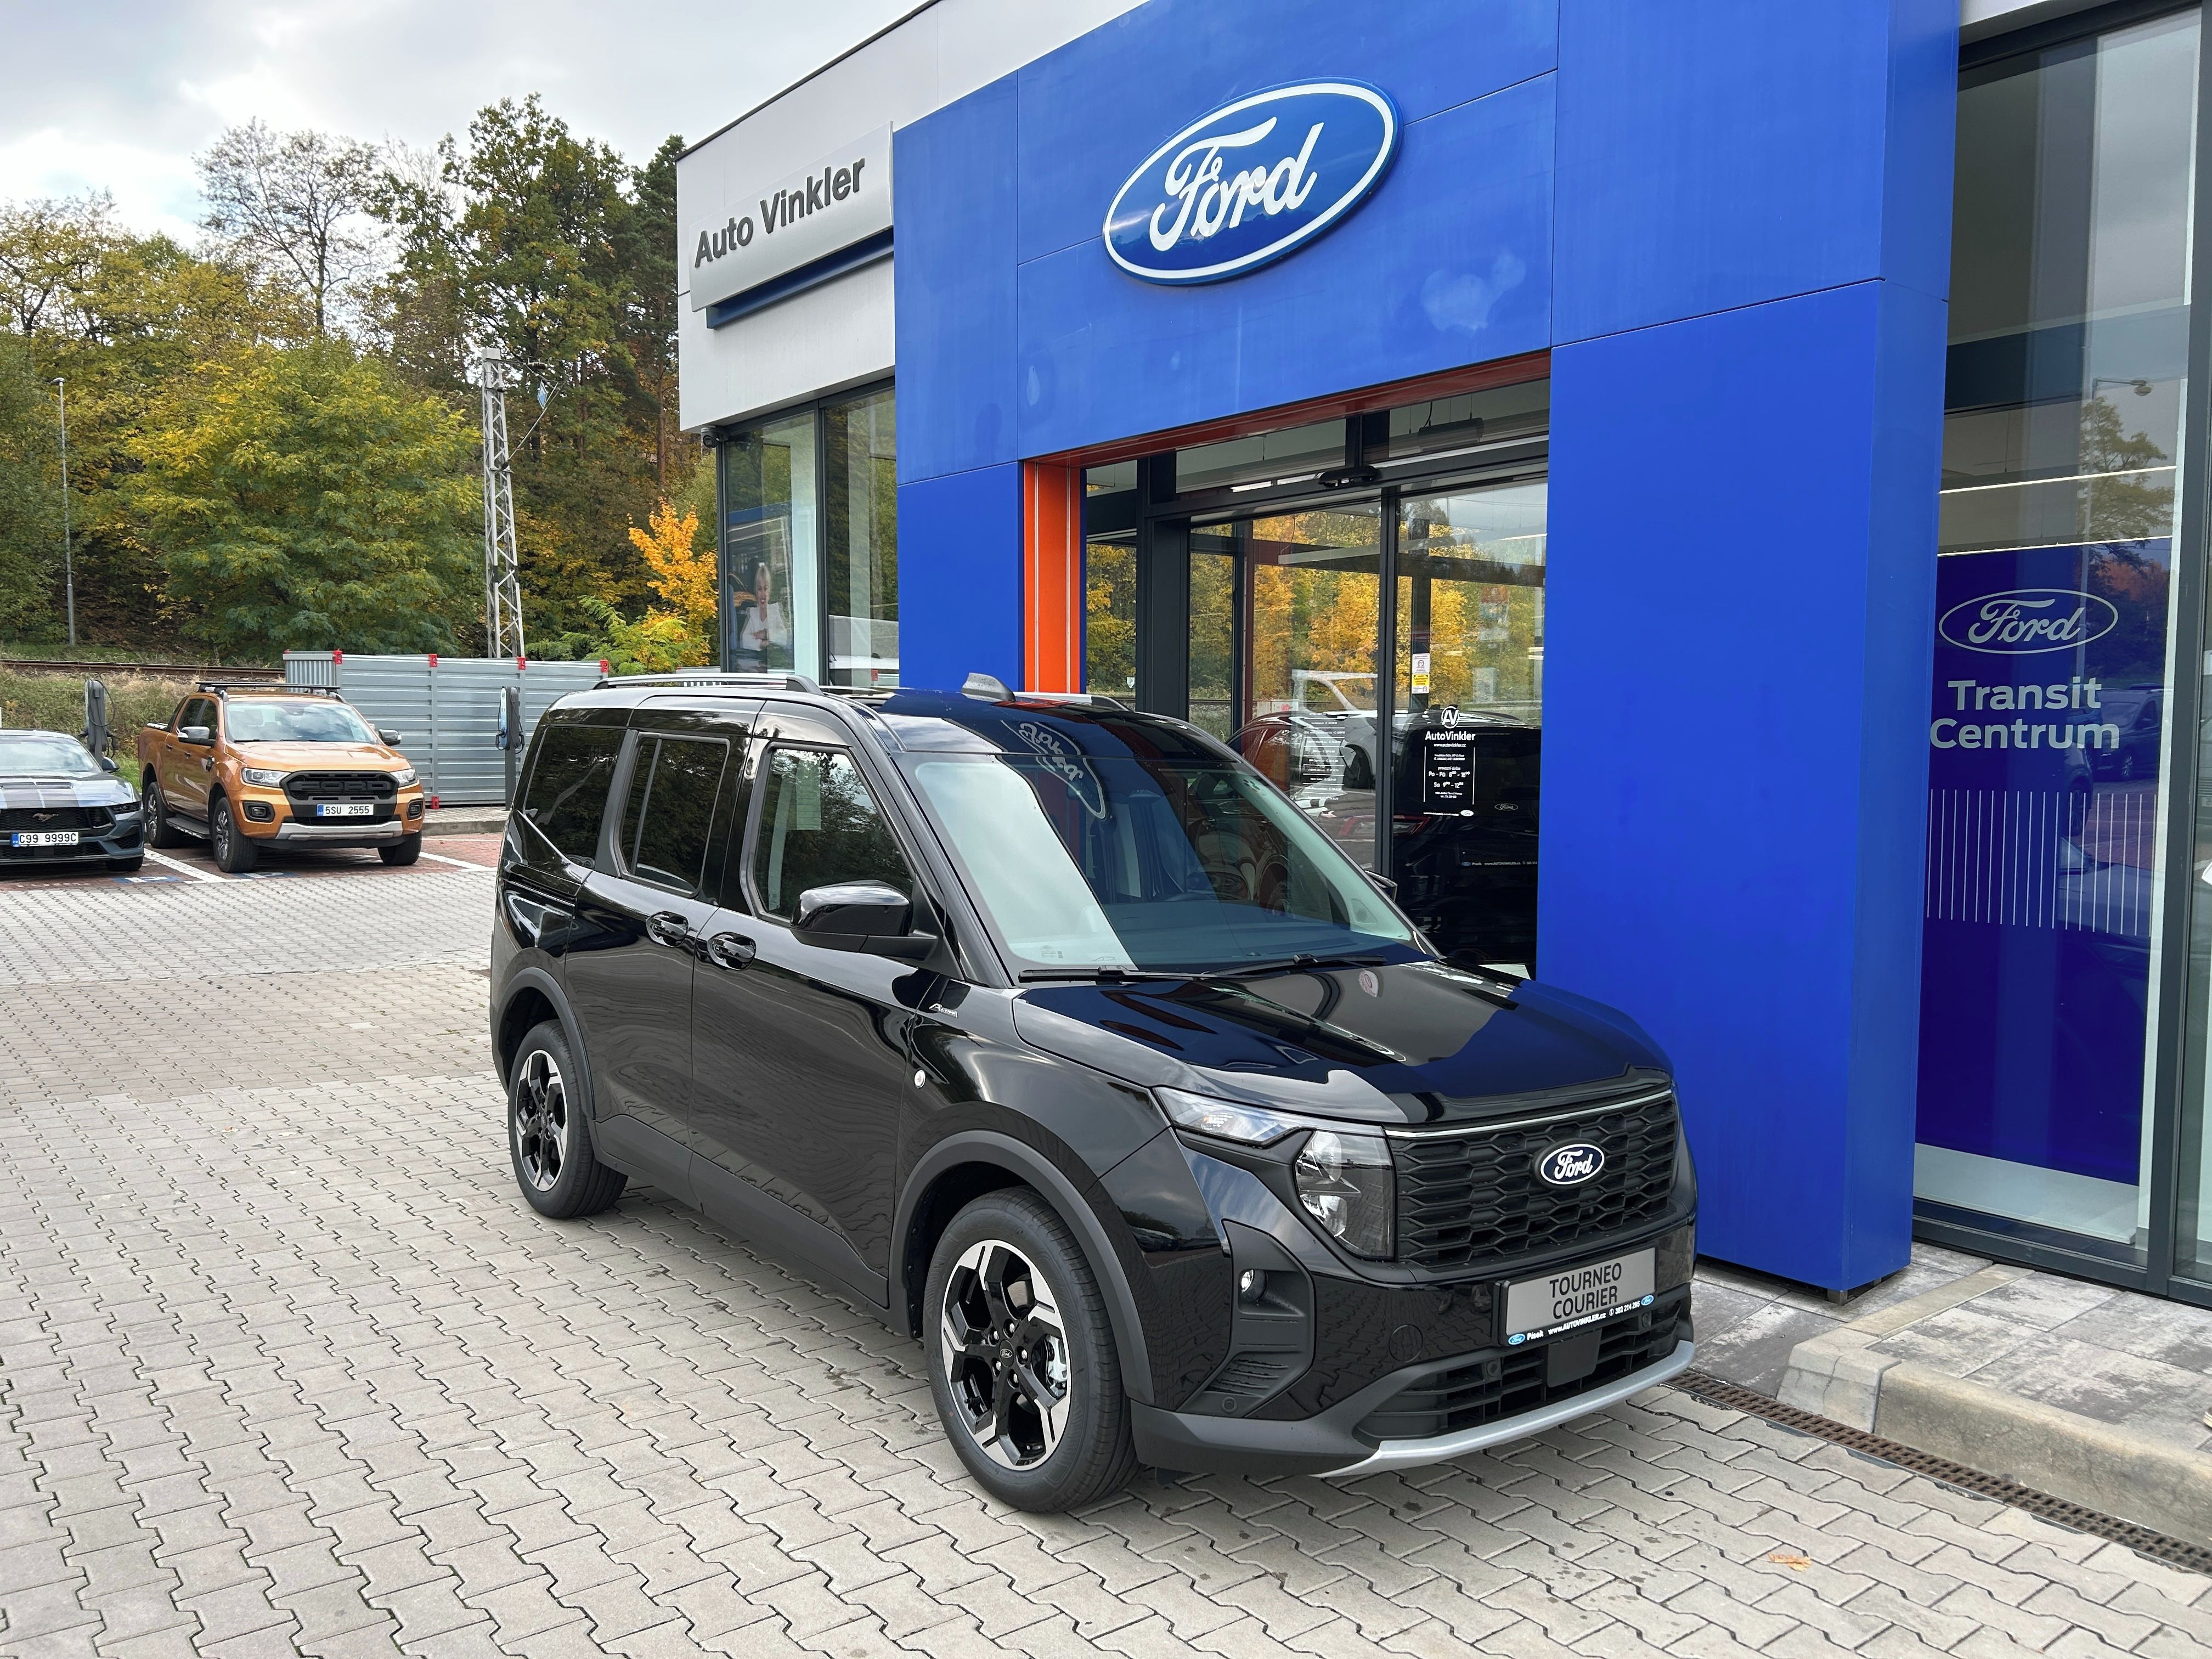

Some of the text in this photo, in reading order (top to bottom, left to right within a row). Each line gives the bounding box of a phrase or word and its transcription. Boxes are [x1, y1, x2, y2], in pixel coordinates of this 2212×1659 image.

[1149, 116, 1324, 251] Ford
[695, 158, 865, 268] Auto Vinkler
[1968, 599, 2085, 644] Ford
[1948, 676, 2102, 710] Transit
[1425, 731, 1476, 741] AutoVinkler
[1930, 718, 2120, 749] Centrum
[325, 805, 369, 815] 5SU 2555
[19, 833, 76, 843] C99 9999C
[1554, 1149, 1593, 1180] Ford
[1549, 1262, 1622, 1298] TOURNEO
[1553, 1285, 1617, 1319] COURIER
[1548, 1313, 1606, 1335] www.AUTOVINKLER.cz
[1624, 1303, 1632, 1312] 214
